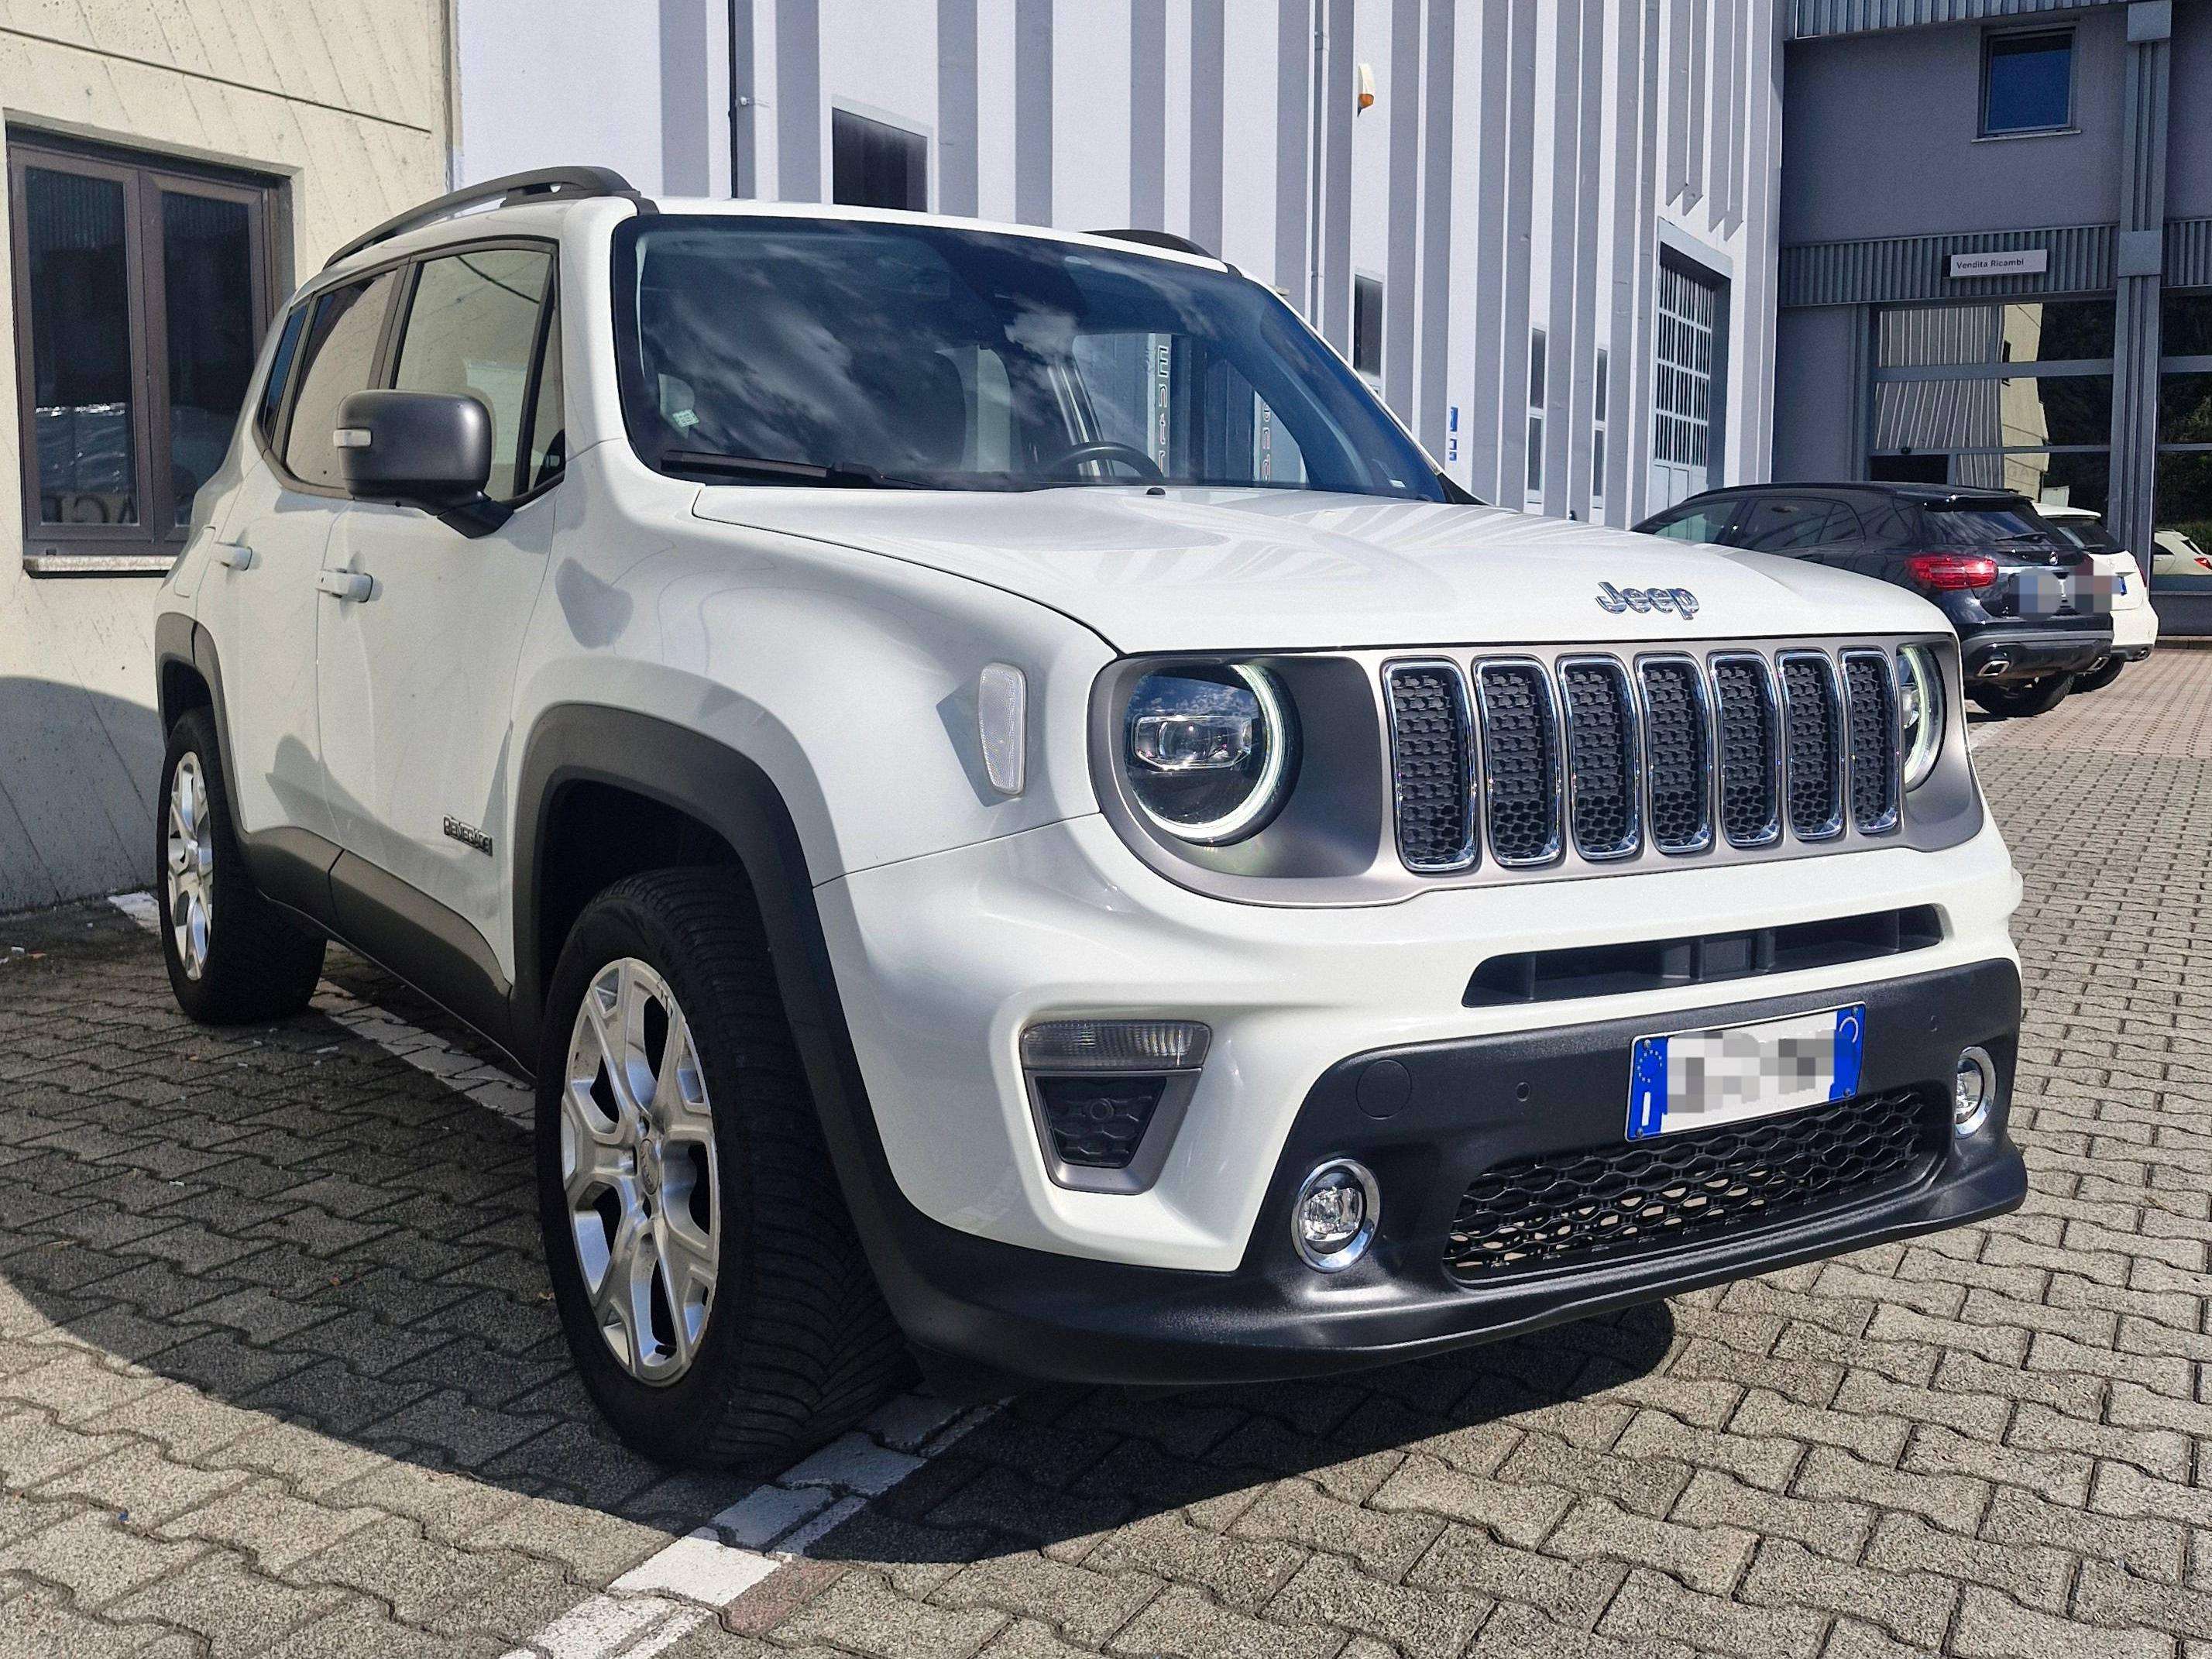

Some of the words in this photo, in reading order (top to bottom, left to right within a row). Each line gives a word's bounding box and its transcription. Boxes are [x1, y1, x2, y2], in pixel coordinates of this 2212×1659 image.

[1956, 260, 1988, 269] Vendita
[1990, 258, 2024, 266] Ricambi
[1595, 582, 1700, 620] Jeep
